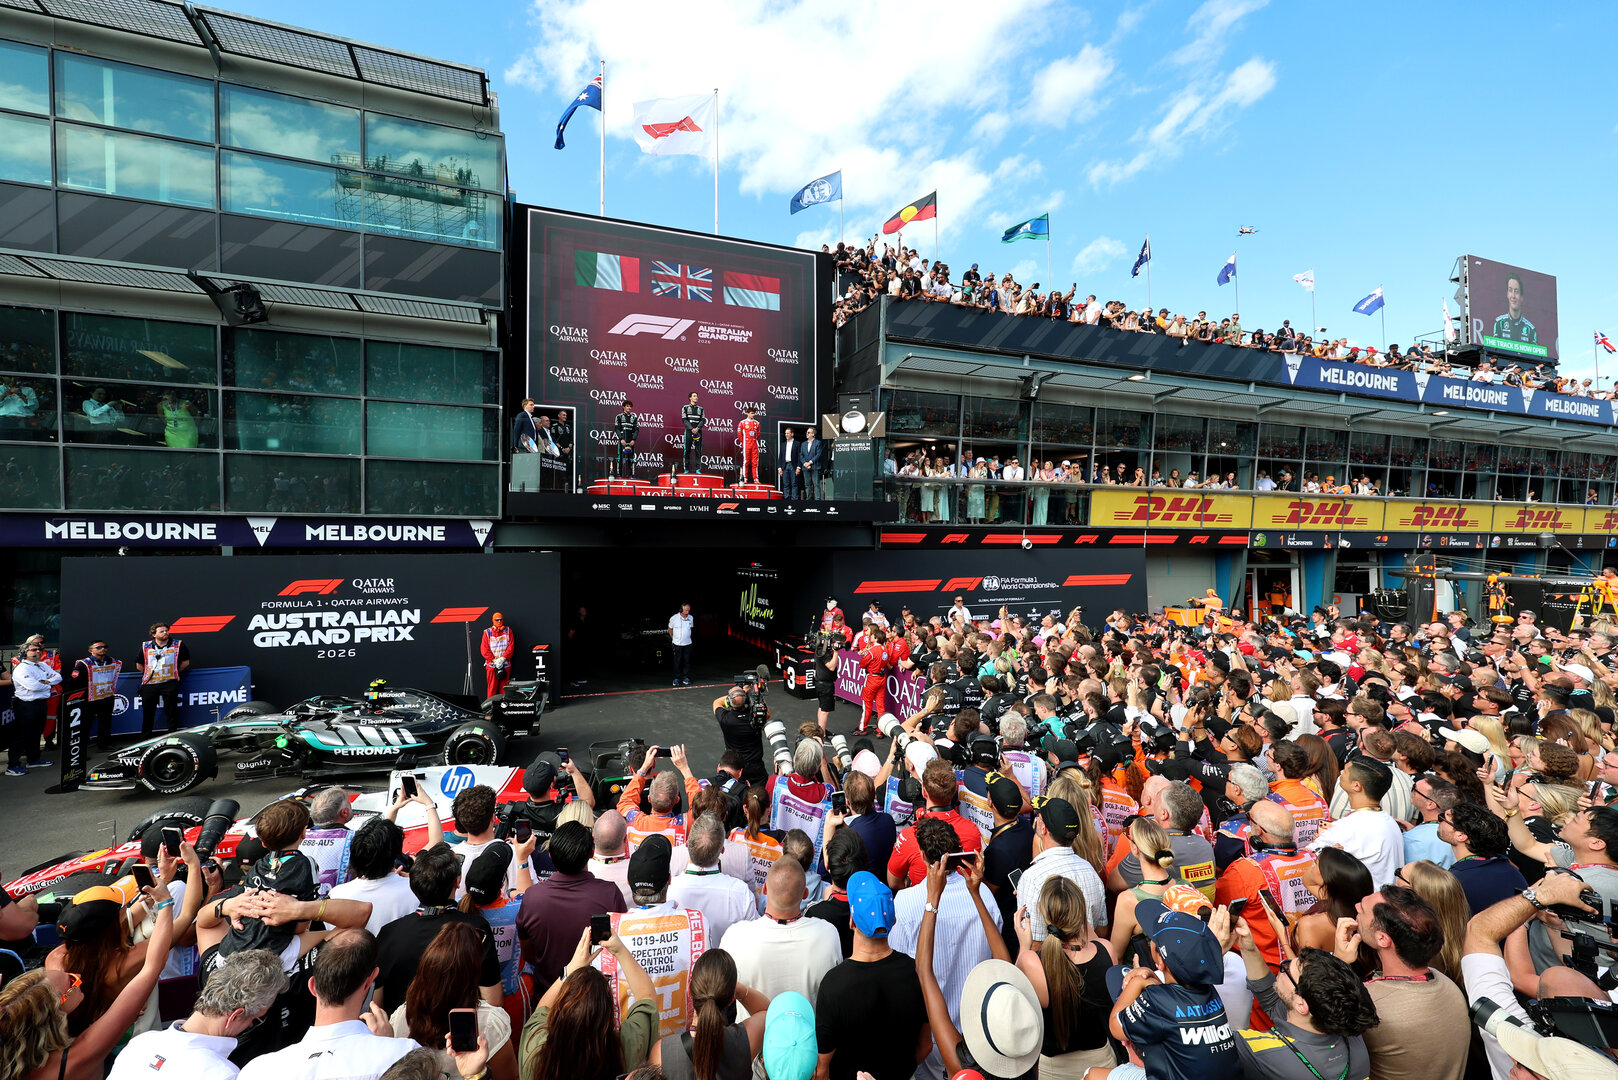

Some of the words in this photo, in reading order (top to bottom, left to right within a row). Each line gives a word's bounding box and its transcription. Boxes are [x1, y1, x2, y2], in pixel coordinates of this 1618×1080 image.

[550, 325, 588, 337] QATAR
[698, 325, 752, 337] AUSTRALIAN
[698, 332, 728, 341] GRAND
[729, 335, 748, 343] PRIX
[768, 348, 798, 358] QATAR
[1497, 340, 1514, 348] TRACK
[1533, 347, 1546, 355] OPEN
[590, 350, 626, 360] QATAR
[664, 357, 699, 368] QATAR
[550, 366, 588, 378] QATAR
[673, 366, 699, 374] AIRWAYS
[734, 364, 766, 374] QATAR
[628, 373, 664, 384] QATAR
[1320, 366, 1398, 392] MELBOURNE
[637, 382, 664, 390] AIRWAYS
[700, 379, 733, 390] QATAR
[768, 385, 798, 395] QATAR
[590, 390, 626, 400] QATAR
[708, 388, 733, 396] AIRWAYS
[1444, 384, 1508, 405] MELBOURNE
[1546, 399, 1599, 417] MELBOURNE
[590, 430, 619, 440] QATA
[634, 452, 664, 462] ATAR
[700, 456, 733, 466] QATAR
[693, 478, 699, 486] 1
[1131, 496, 1214, 522] DHL
[1286, 502, 1356, 524] DHL
[1411, 506, 1468, 526] DHL
[1514, 510, 1564, 528] DHL
[45, 520, 216, 540] MELBOURNE
[306, 524, 445, 542] MELBOURNE
[1280, 536, 1284, 546] 1
[1440, 536, 1448, 546] 81
[352, 578, 394, 588] QATAR
[1019, 582, 1056, 590] Championship
[331, 599, 363, 607] QATAR
[248, 609, 420, 630] AUSTRALIAN
[254, 629, 350, 648] GRAND
[354, 626, 414, 643] PRIX
[318, 649, 356, 658] 2026
[536, 656, 545, 669] 1
[787, 666, 795, 690] 3
[189, 686, 247, 706] FERMÉ
[70, 708, 81, 728] 2
[334, 746, 400, 756] PETRONAS
[120, 758, 140, 767] IWC
[444, 766, 472, 799] hp
[163, 812, 202, 822] ZERO
[785, 806, 814, 822] 1874-AUS
[1296, 819, 1317, 827] 0037-AU
[1185, 864, 1213, 879] PIRELLI
[25, 875, 65, 892] UniCredit
[632, 932, 679, 946] 1019-AUS
[632, 946, 678, 958] SPECTATOR
[644, 965, 675, 974] ARSHAL
[1211, 1046, 1219, 1054] F1
